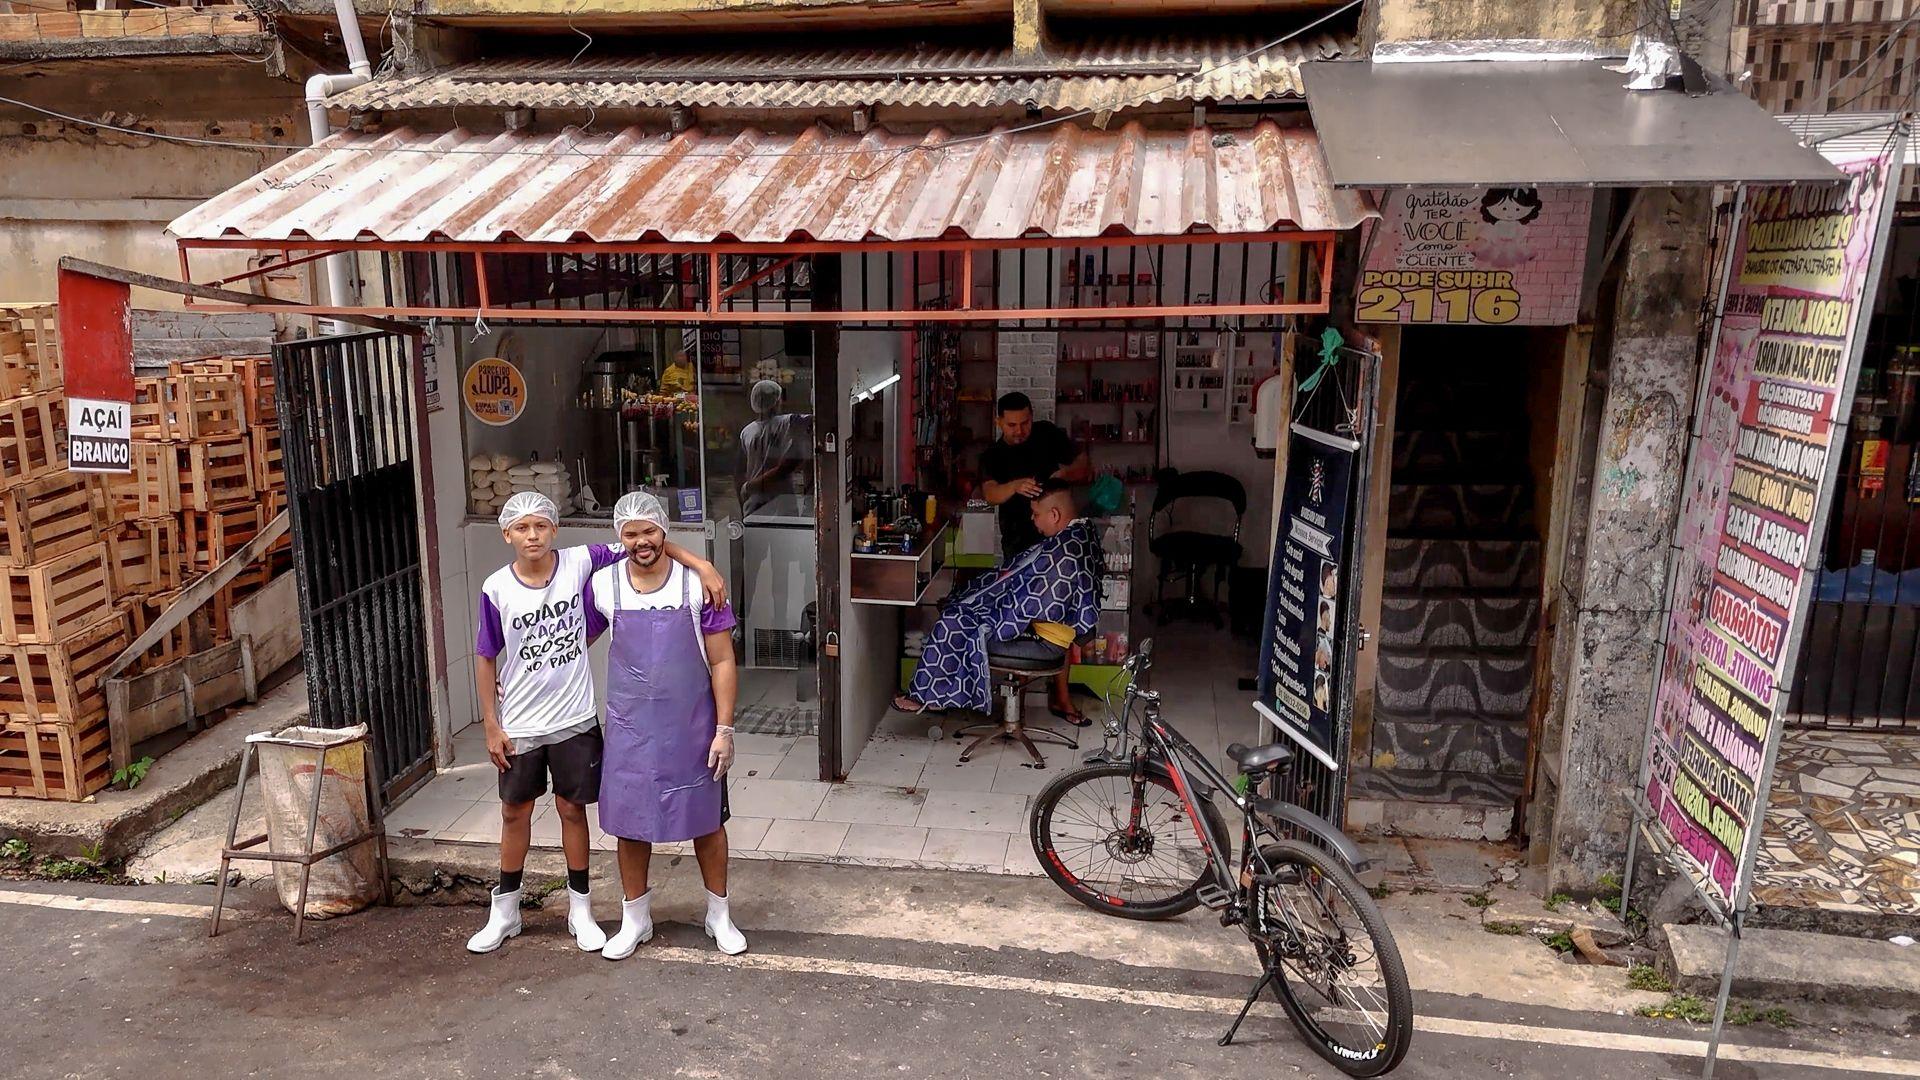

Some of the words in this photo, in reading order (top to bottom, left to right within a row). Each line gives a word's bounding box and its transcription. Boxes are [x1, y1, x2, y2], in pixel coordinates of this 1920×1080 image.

[1424, 210, 1451, 219] TER
[1404, 219, 1471, 240] VOCÊ
[1404, 242, 1457, 251] como
[1405, 254, 1467, 267] CLIENTE
[1363, 270, 1435, 287] PODE
[1436, 270, 1514, 288] SUBIR
[1357, 287, 1521, 324] 2116
[80, 406, 122, 432] AÇAÍ
[72, 440, 128, 464] BRANCO
[512, 593, 580, 630] CRIADO
[538, 611, 573, 639] AÇAÍ
[519, 626, 583, 660] GROSSO
